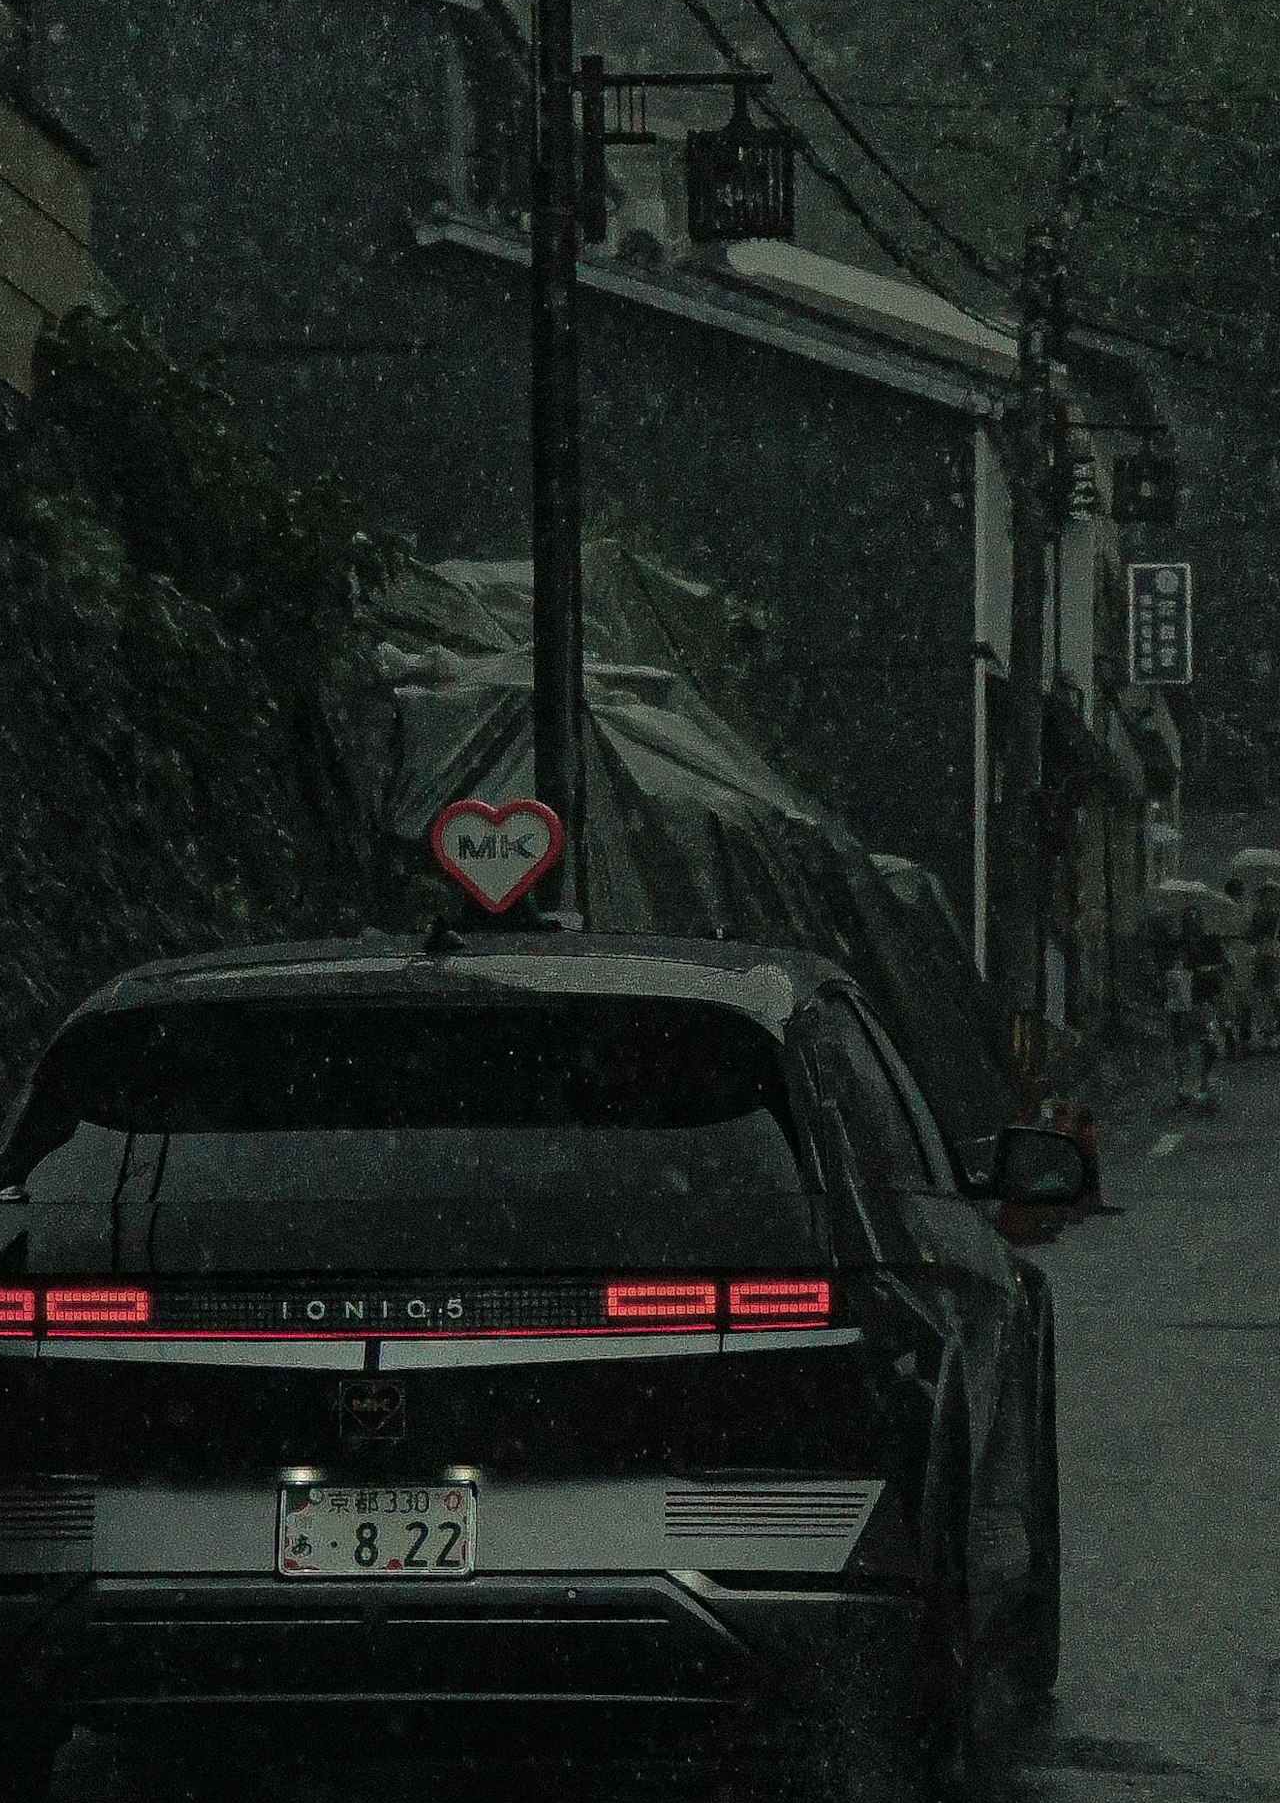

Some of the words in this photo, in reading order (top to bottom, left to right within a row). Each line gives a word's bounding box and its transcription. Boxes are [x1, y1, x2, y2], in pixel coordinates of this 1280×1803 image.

[457, 833, 538, 860] MK
[282, 1299, 427, 1321] IONIQ
[447, 1298, 463, 1319] 5
